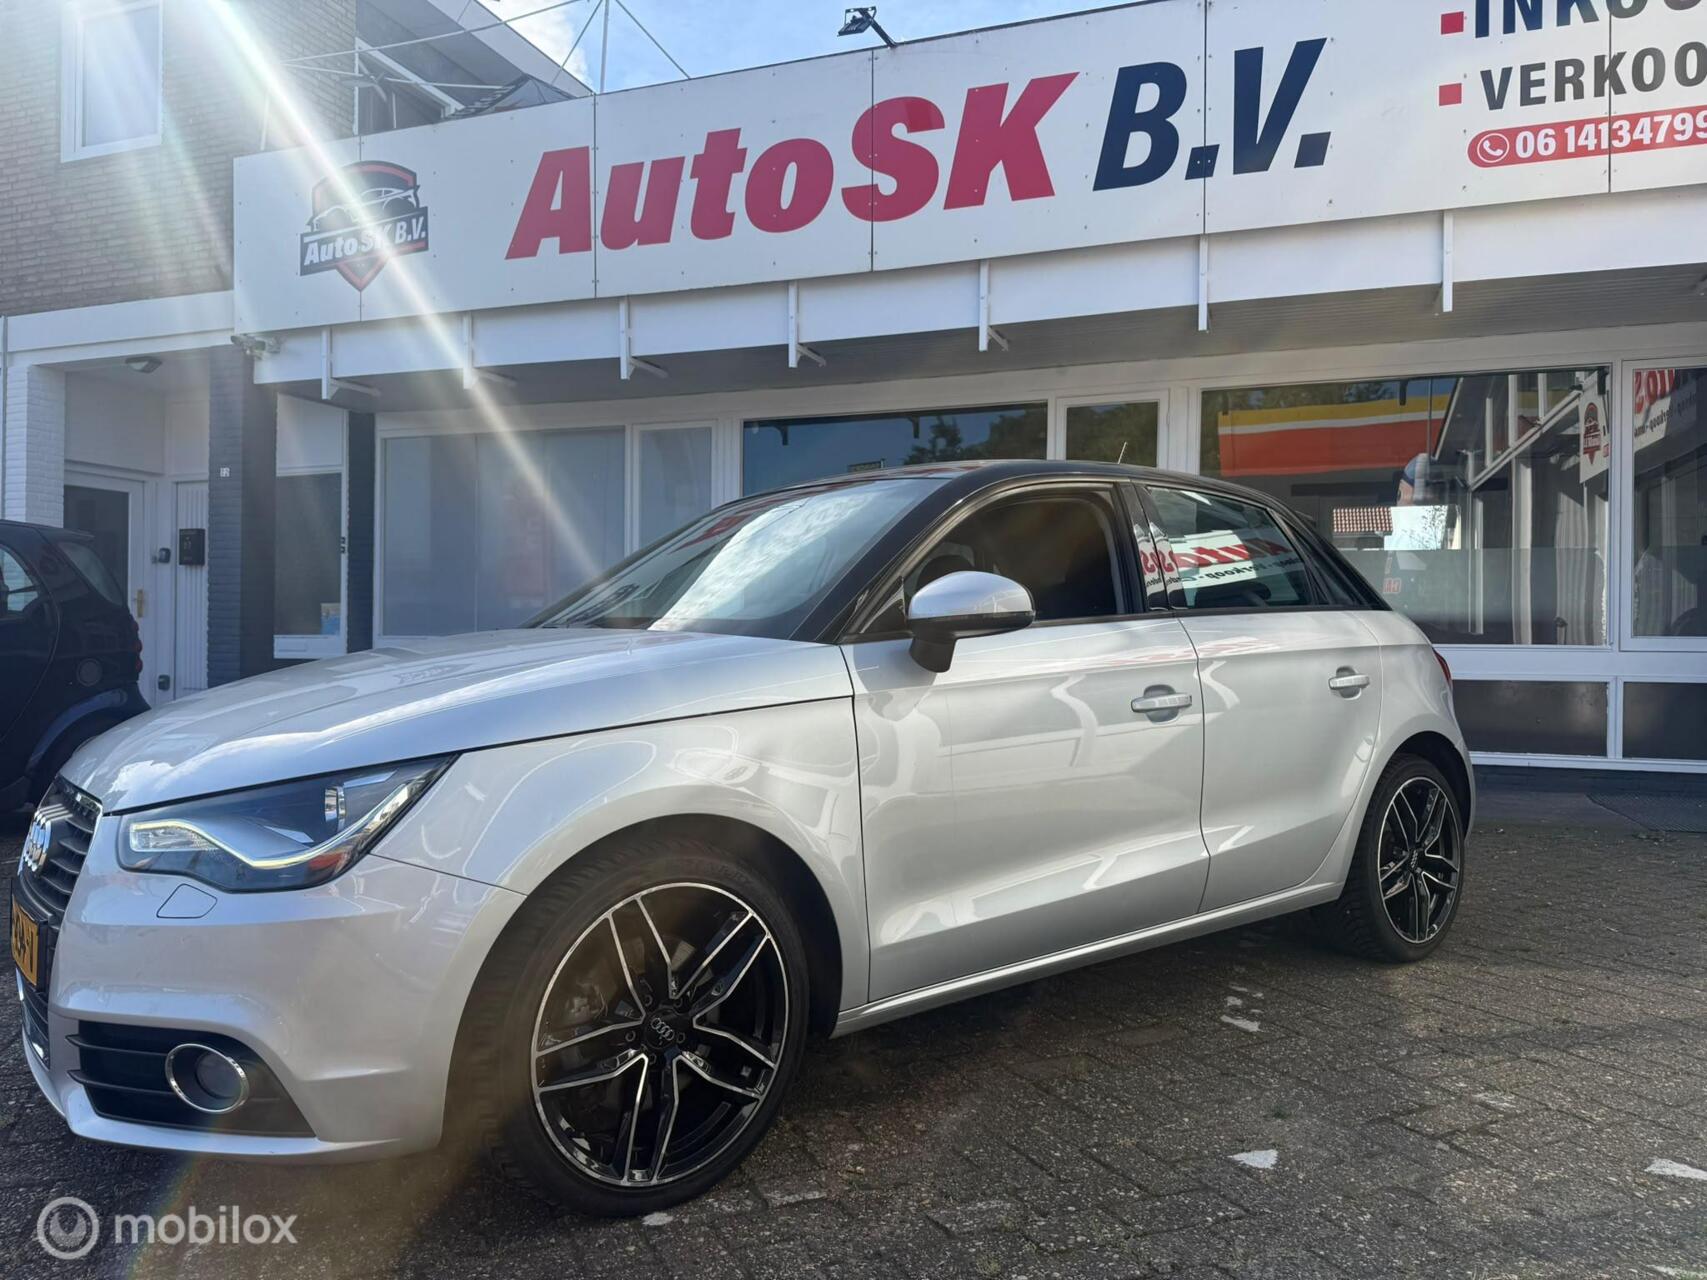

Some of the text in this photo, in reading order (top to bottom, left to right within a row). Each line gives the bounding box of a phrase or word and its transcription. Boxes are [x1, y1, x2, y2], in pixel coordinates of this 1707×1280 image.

[1480, 41, 1707, 111] VERKOO
[505, 37, 1332, 261] AutoSK B.V.
[1515, 112, 1707, 159] 06 14134799
[303, 215, 426, 266] AutoSK B.V.
